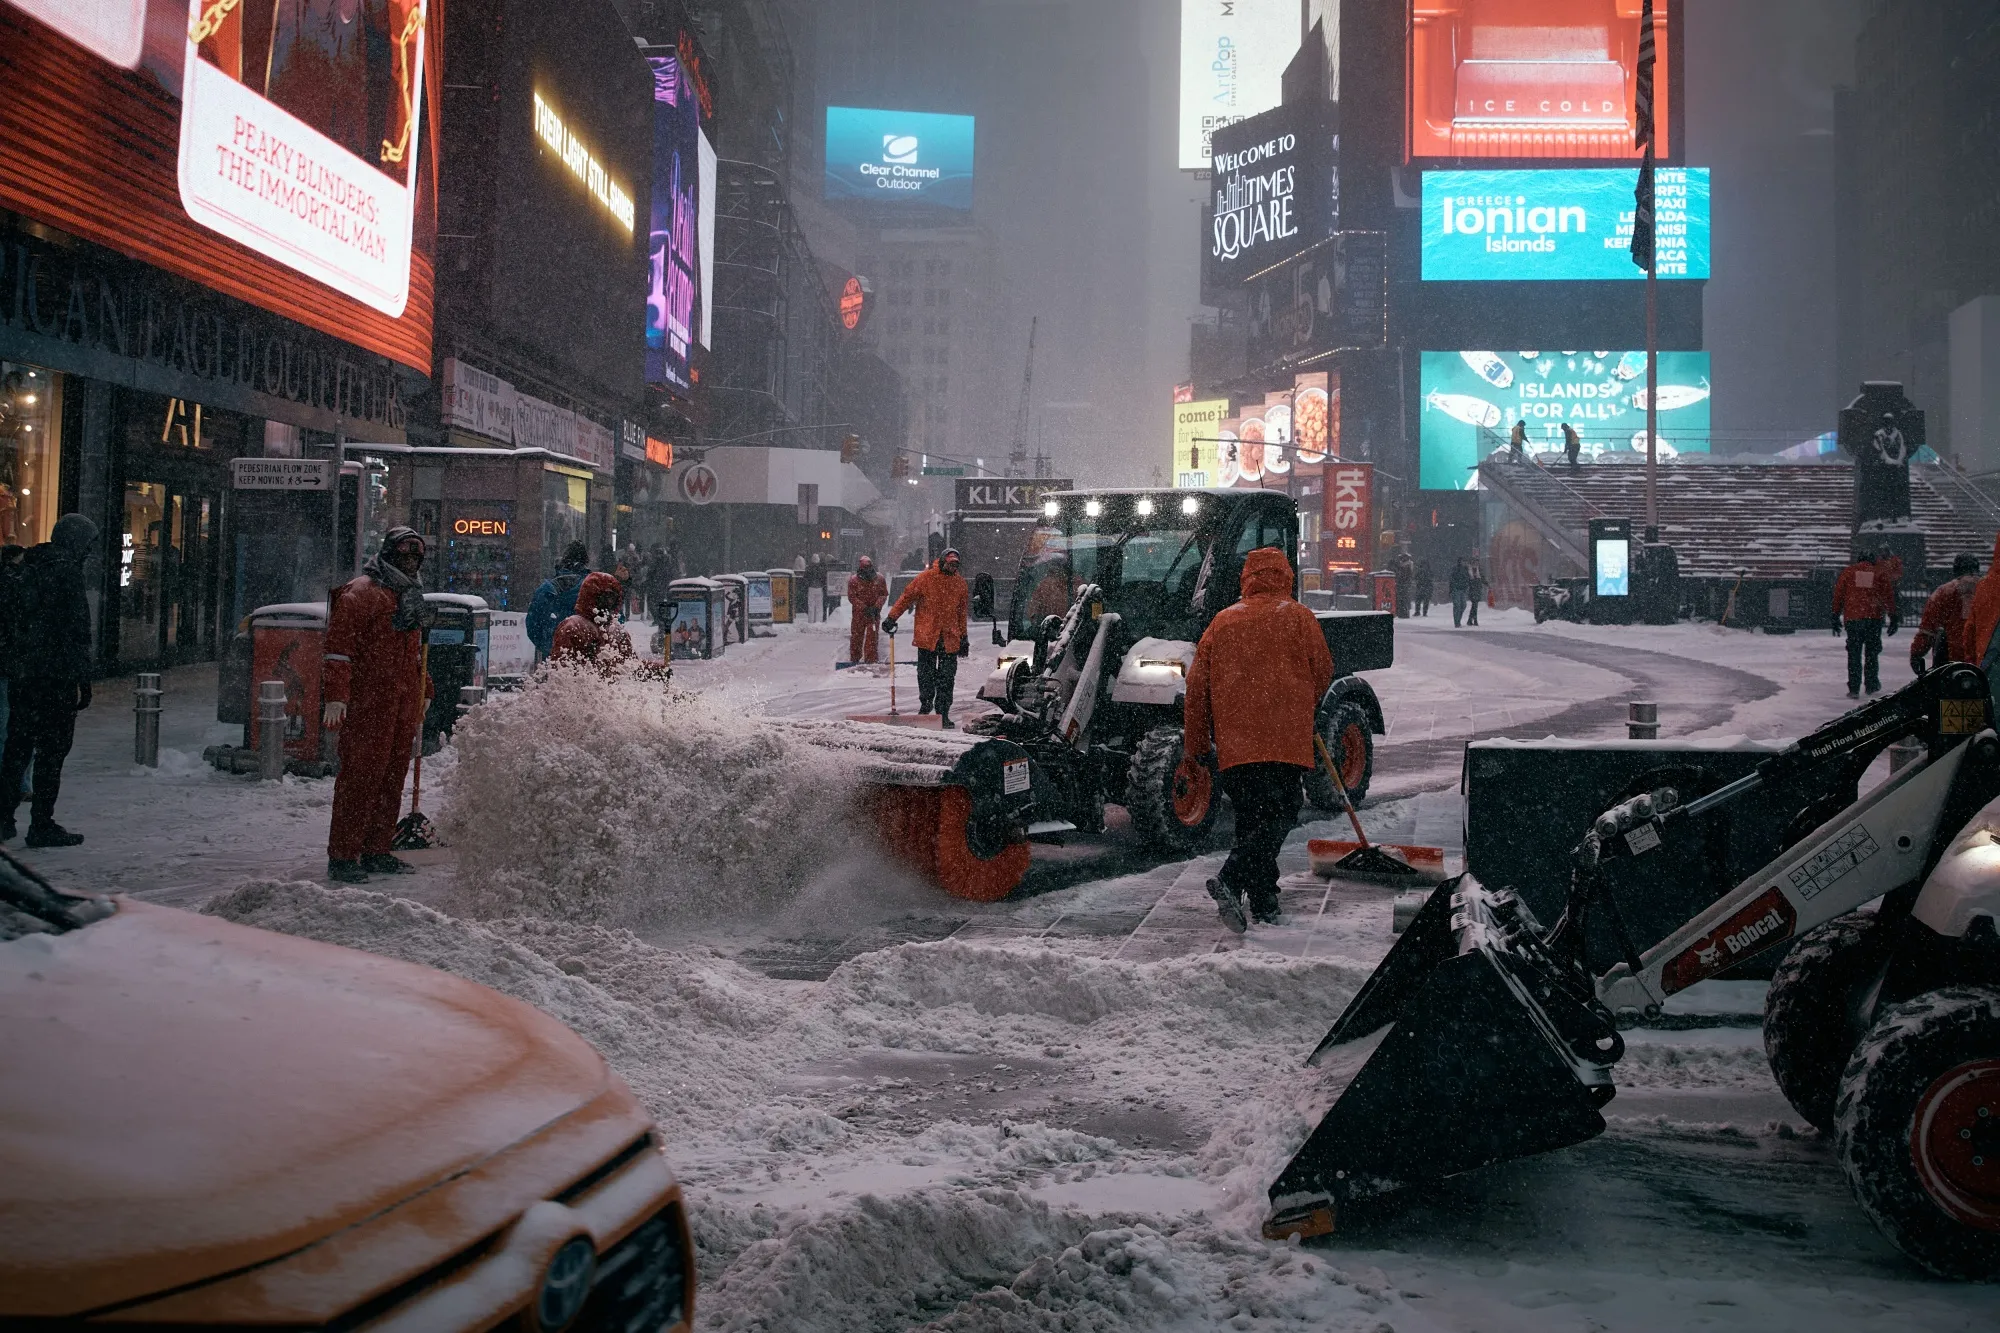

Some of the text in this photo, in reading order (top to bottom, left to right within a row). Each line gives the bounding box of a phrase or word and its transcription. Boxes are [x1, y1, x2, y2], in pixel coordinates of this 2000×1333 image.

[1212, 36, 1231, 105] ArtPop
[1469, 100, 1614, 113] ICE COLD
[534, 92, 635, 232] THEIR LIGHT STILL SHINES
[1214, 134, 1295, 175] WELCOME TO
[233, 115, 380, 226] PEAKY BLINDERS:
[860, 163, 939, 178] Clear Channel
[1655, 172, 1687, 183] NTE
[876, 177, 922, 190] Outdoor
[1246, 165, 1295, 205] TIMES
[1655, 185, 1687, 196] RFU
[216, 144, 387, 264] THE IMMORTAL MAN
[1456, 195, 1512, 206] GREECE
[1443, 196, 1586, 235] Ionian
[1620, 211, 1687, 222] LEADA
[1213, 195, 1298, 262] SQUARE.
[1486, 235, 1556, 253] Islands
[1656, 250, 1687, 260] ACA
[140, 294, 255, 386] EAGLE
[263, 334, 407, 430] OUTFITTERS
[1520, 383, 1610, 399] ISLANDS
[1179, 410, 1215, 424] come
[1520, 403, 1609, 418] FOR ALL
[239, 464, 322, 474] PEDESTRIAN FLOW ZONE
[239, 476, 284, 485] KEEP MOVING
[1335, 469, 1365, 529] tkts
[455, 519, 506, 535] OPEN
[1811, 713, 1899, 758] High Flow Hydraulics
[1723, 908, 1785, 954] Bobcat
